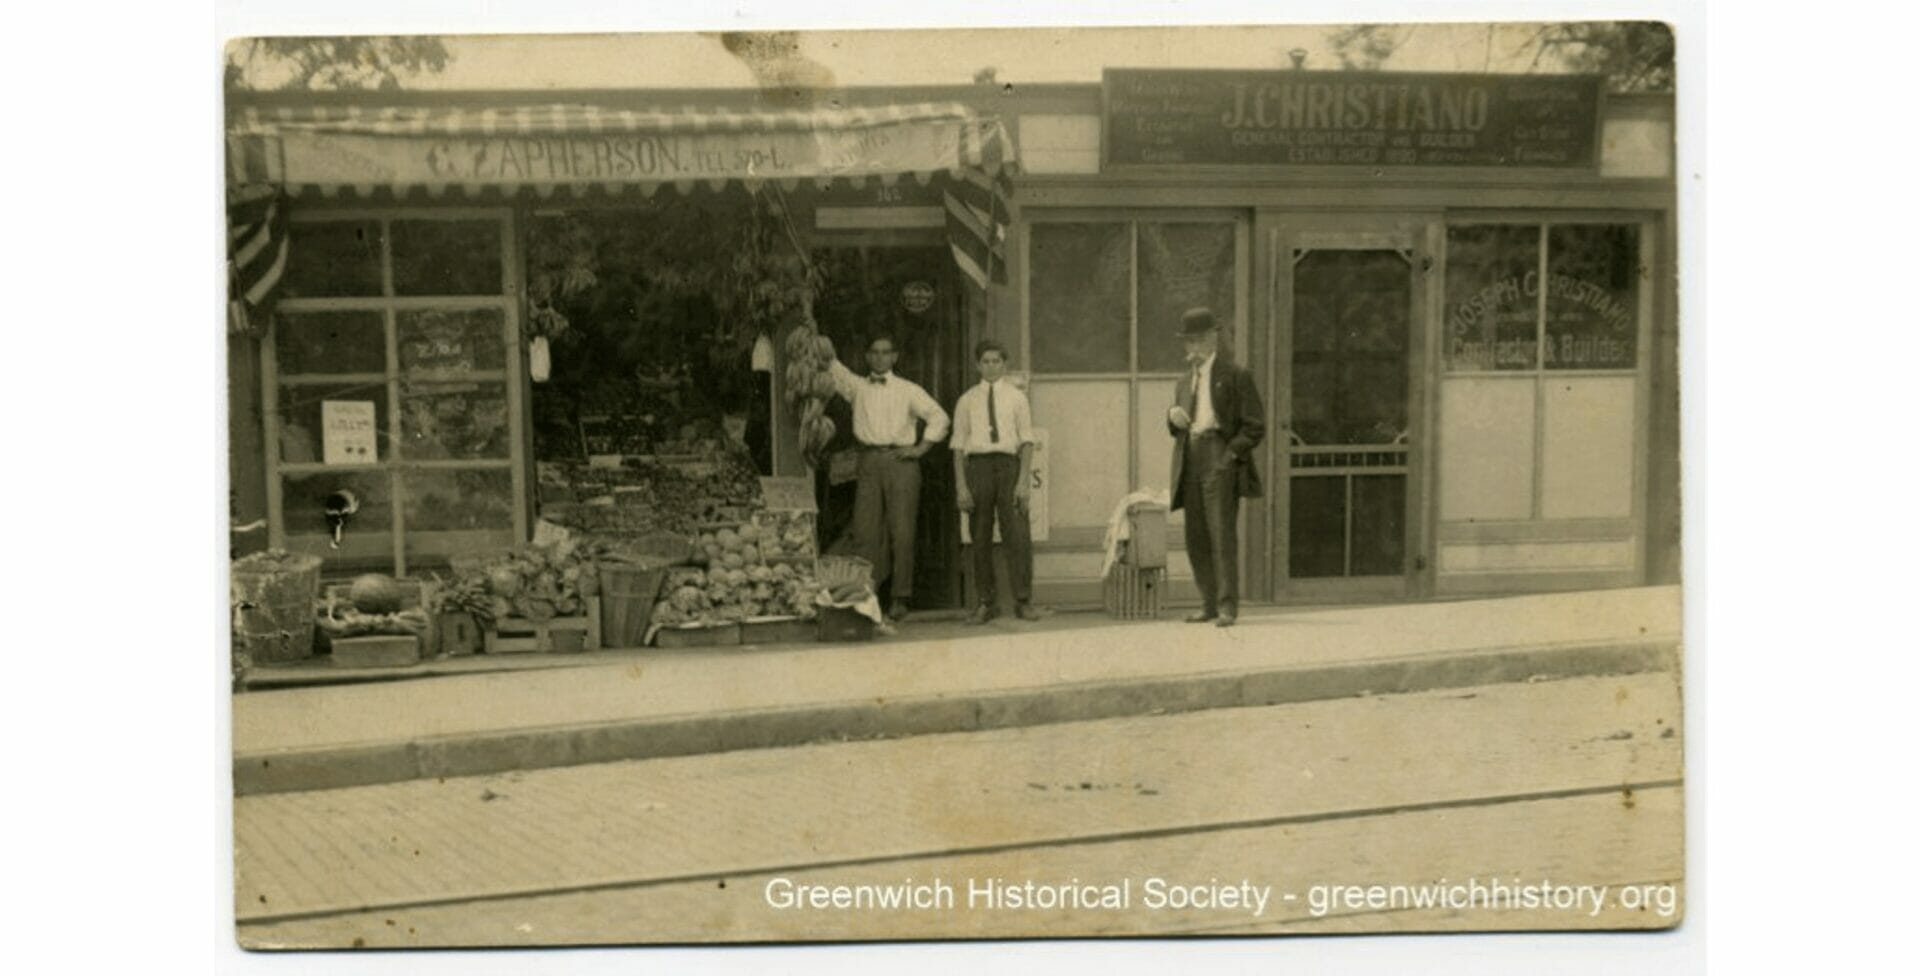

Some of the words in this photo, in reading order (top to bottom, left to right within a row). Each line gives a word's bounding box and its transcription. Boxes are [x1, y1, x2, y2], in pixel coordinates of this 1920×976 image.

[1231, 131, 1292, 147] GENERAL
[1298, 131, 1384, 147] CONTRACTOR
[1288, 147, 1377, 163] ESTABLISHED
[1451, 276, 1520, 335] JOSEPH
[1523, 270, 1633, 331] CHRISTIANO
